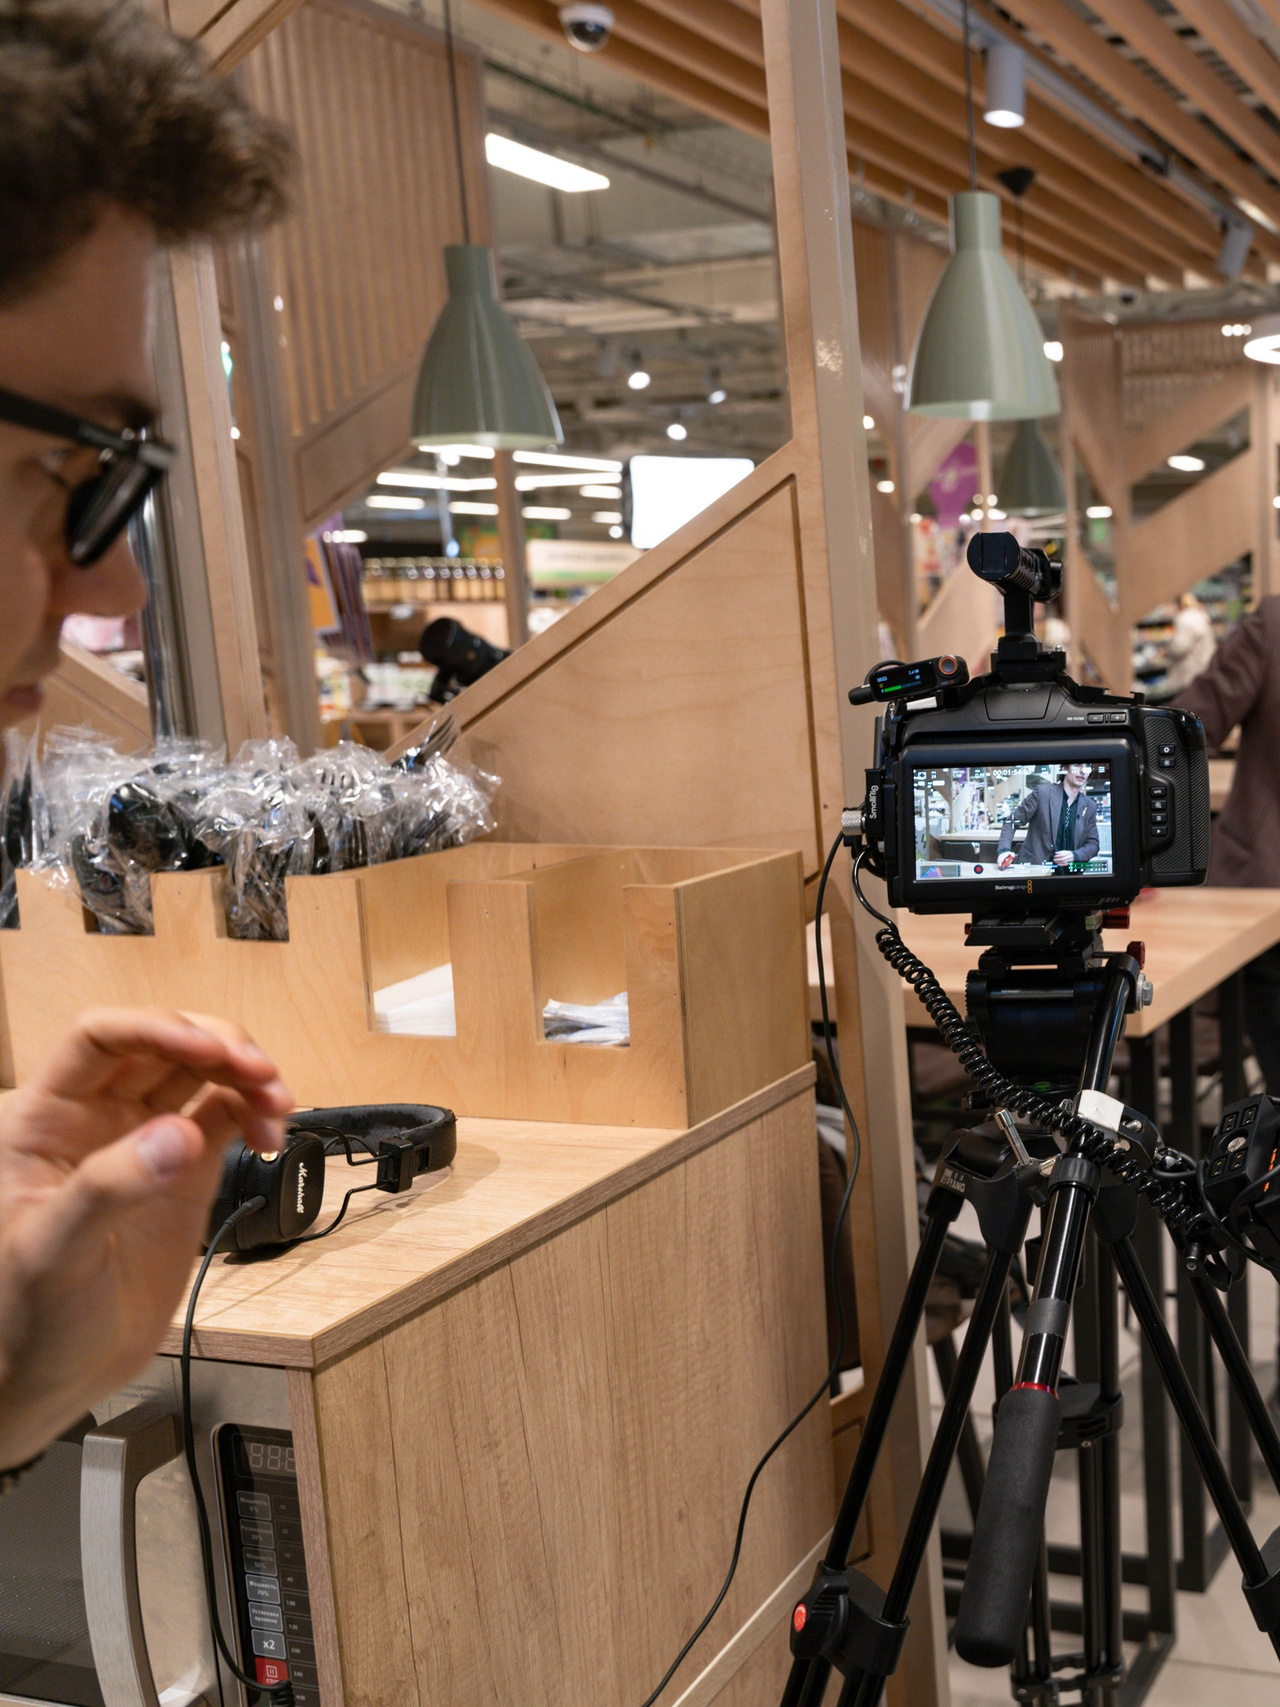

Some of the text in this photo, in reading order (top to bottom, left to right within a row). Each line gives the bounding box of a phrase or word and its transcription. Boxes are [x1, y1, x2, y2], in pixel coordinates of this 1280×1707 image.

[869, 785, 879, 819] SmallRig
[297, 1162, 308, 1214] Marshall
[248, 1580, 277, 1590] Мощность
[257, 1589, 269, 1597] 70%
[251, 1608, 280, 1618] Установка
[262, 1640, 276, 1650] x2
